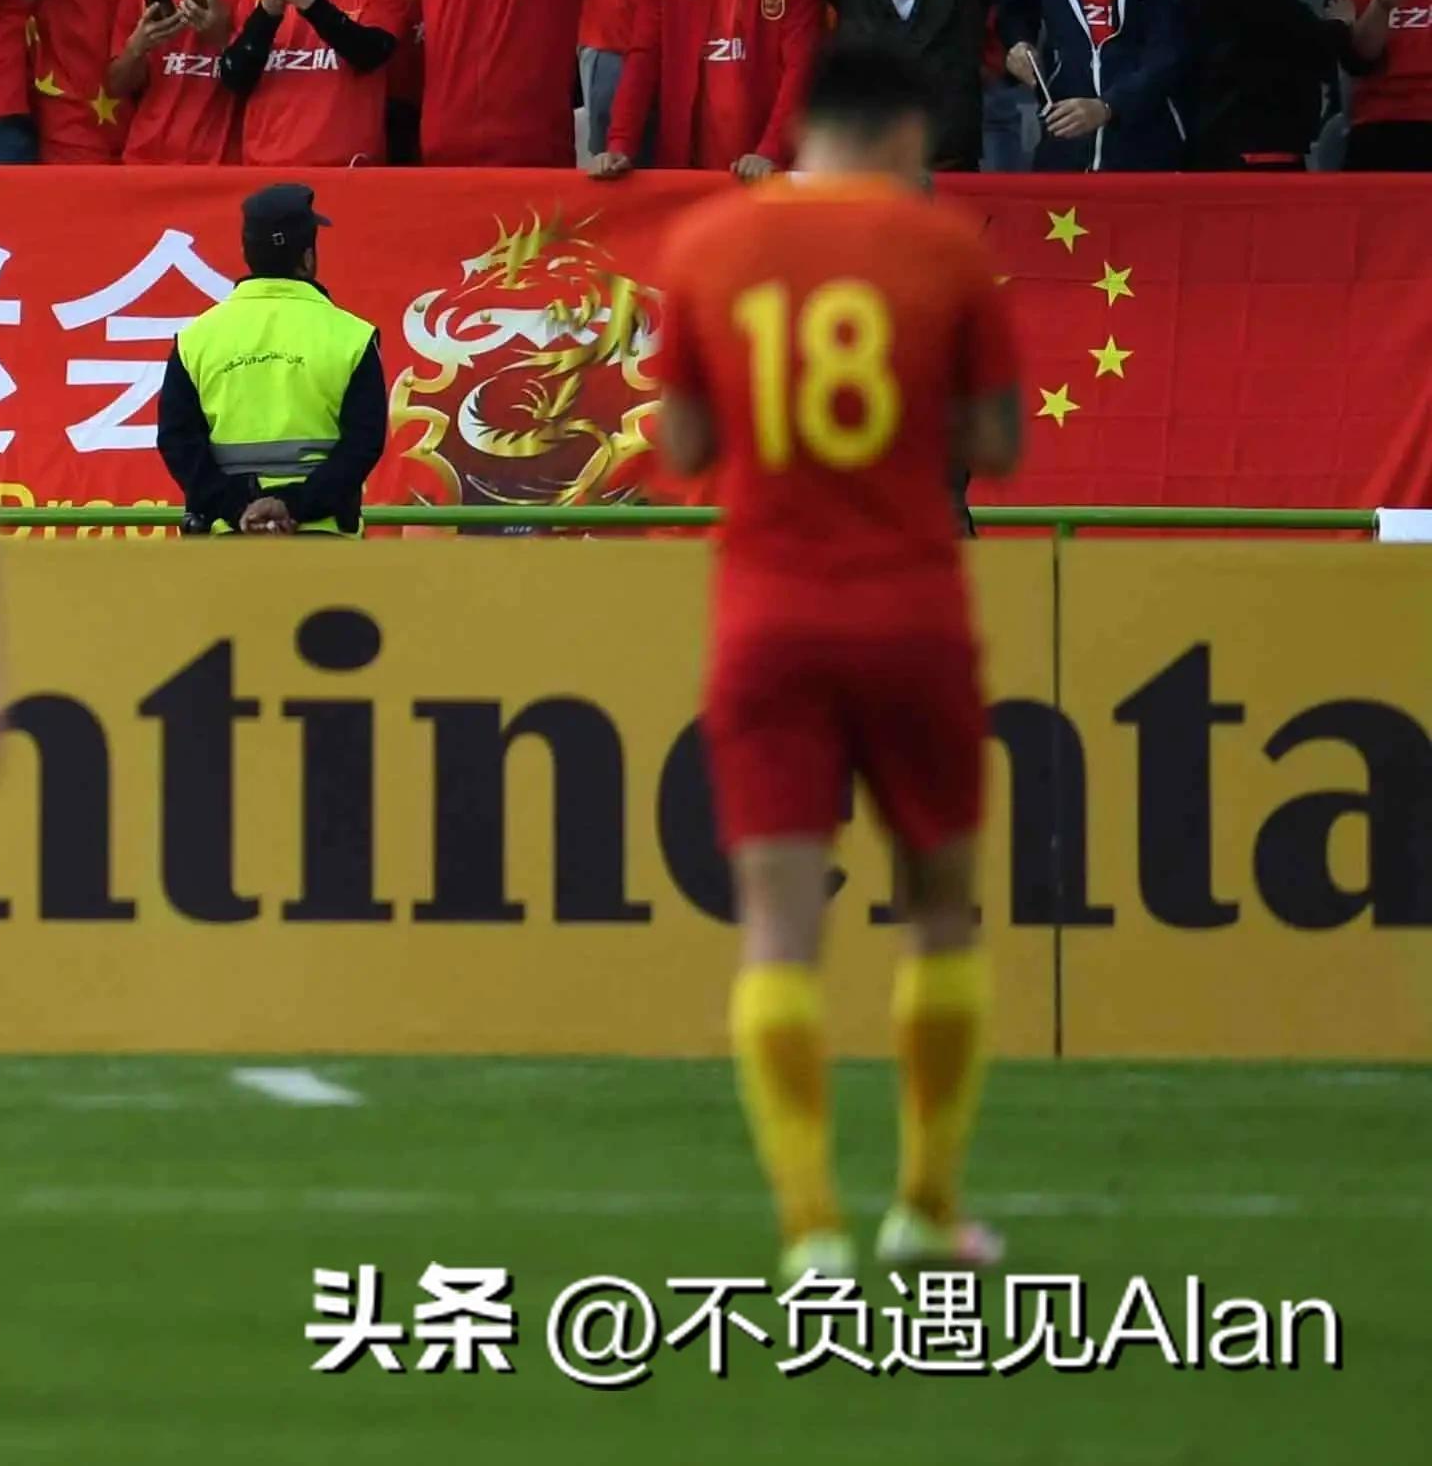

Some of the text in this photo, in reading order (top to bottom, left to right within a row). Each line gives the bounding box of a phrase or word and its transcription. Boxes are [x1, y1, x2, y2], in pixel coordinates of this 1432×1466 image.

[265, 49, 338, 72] 龙之队
[734, 278, 902, 472] 18
